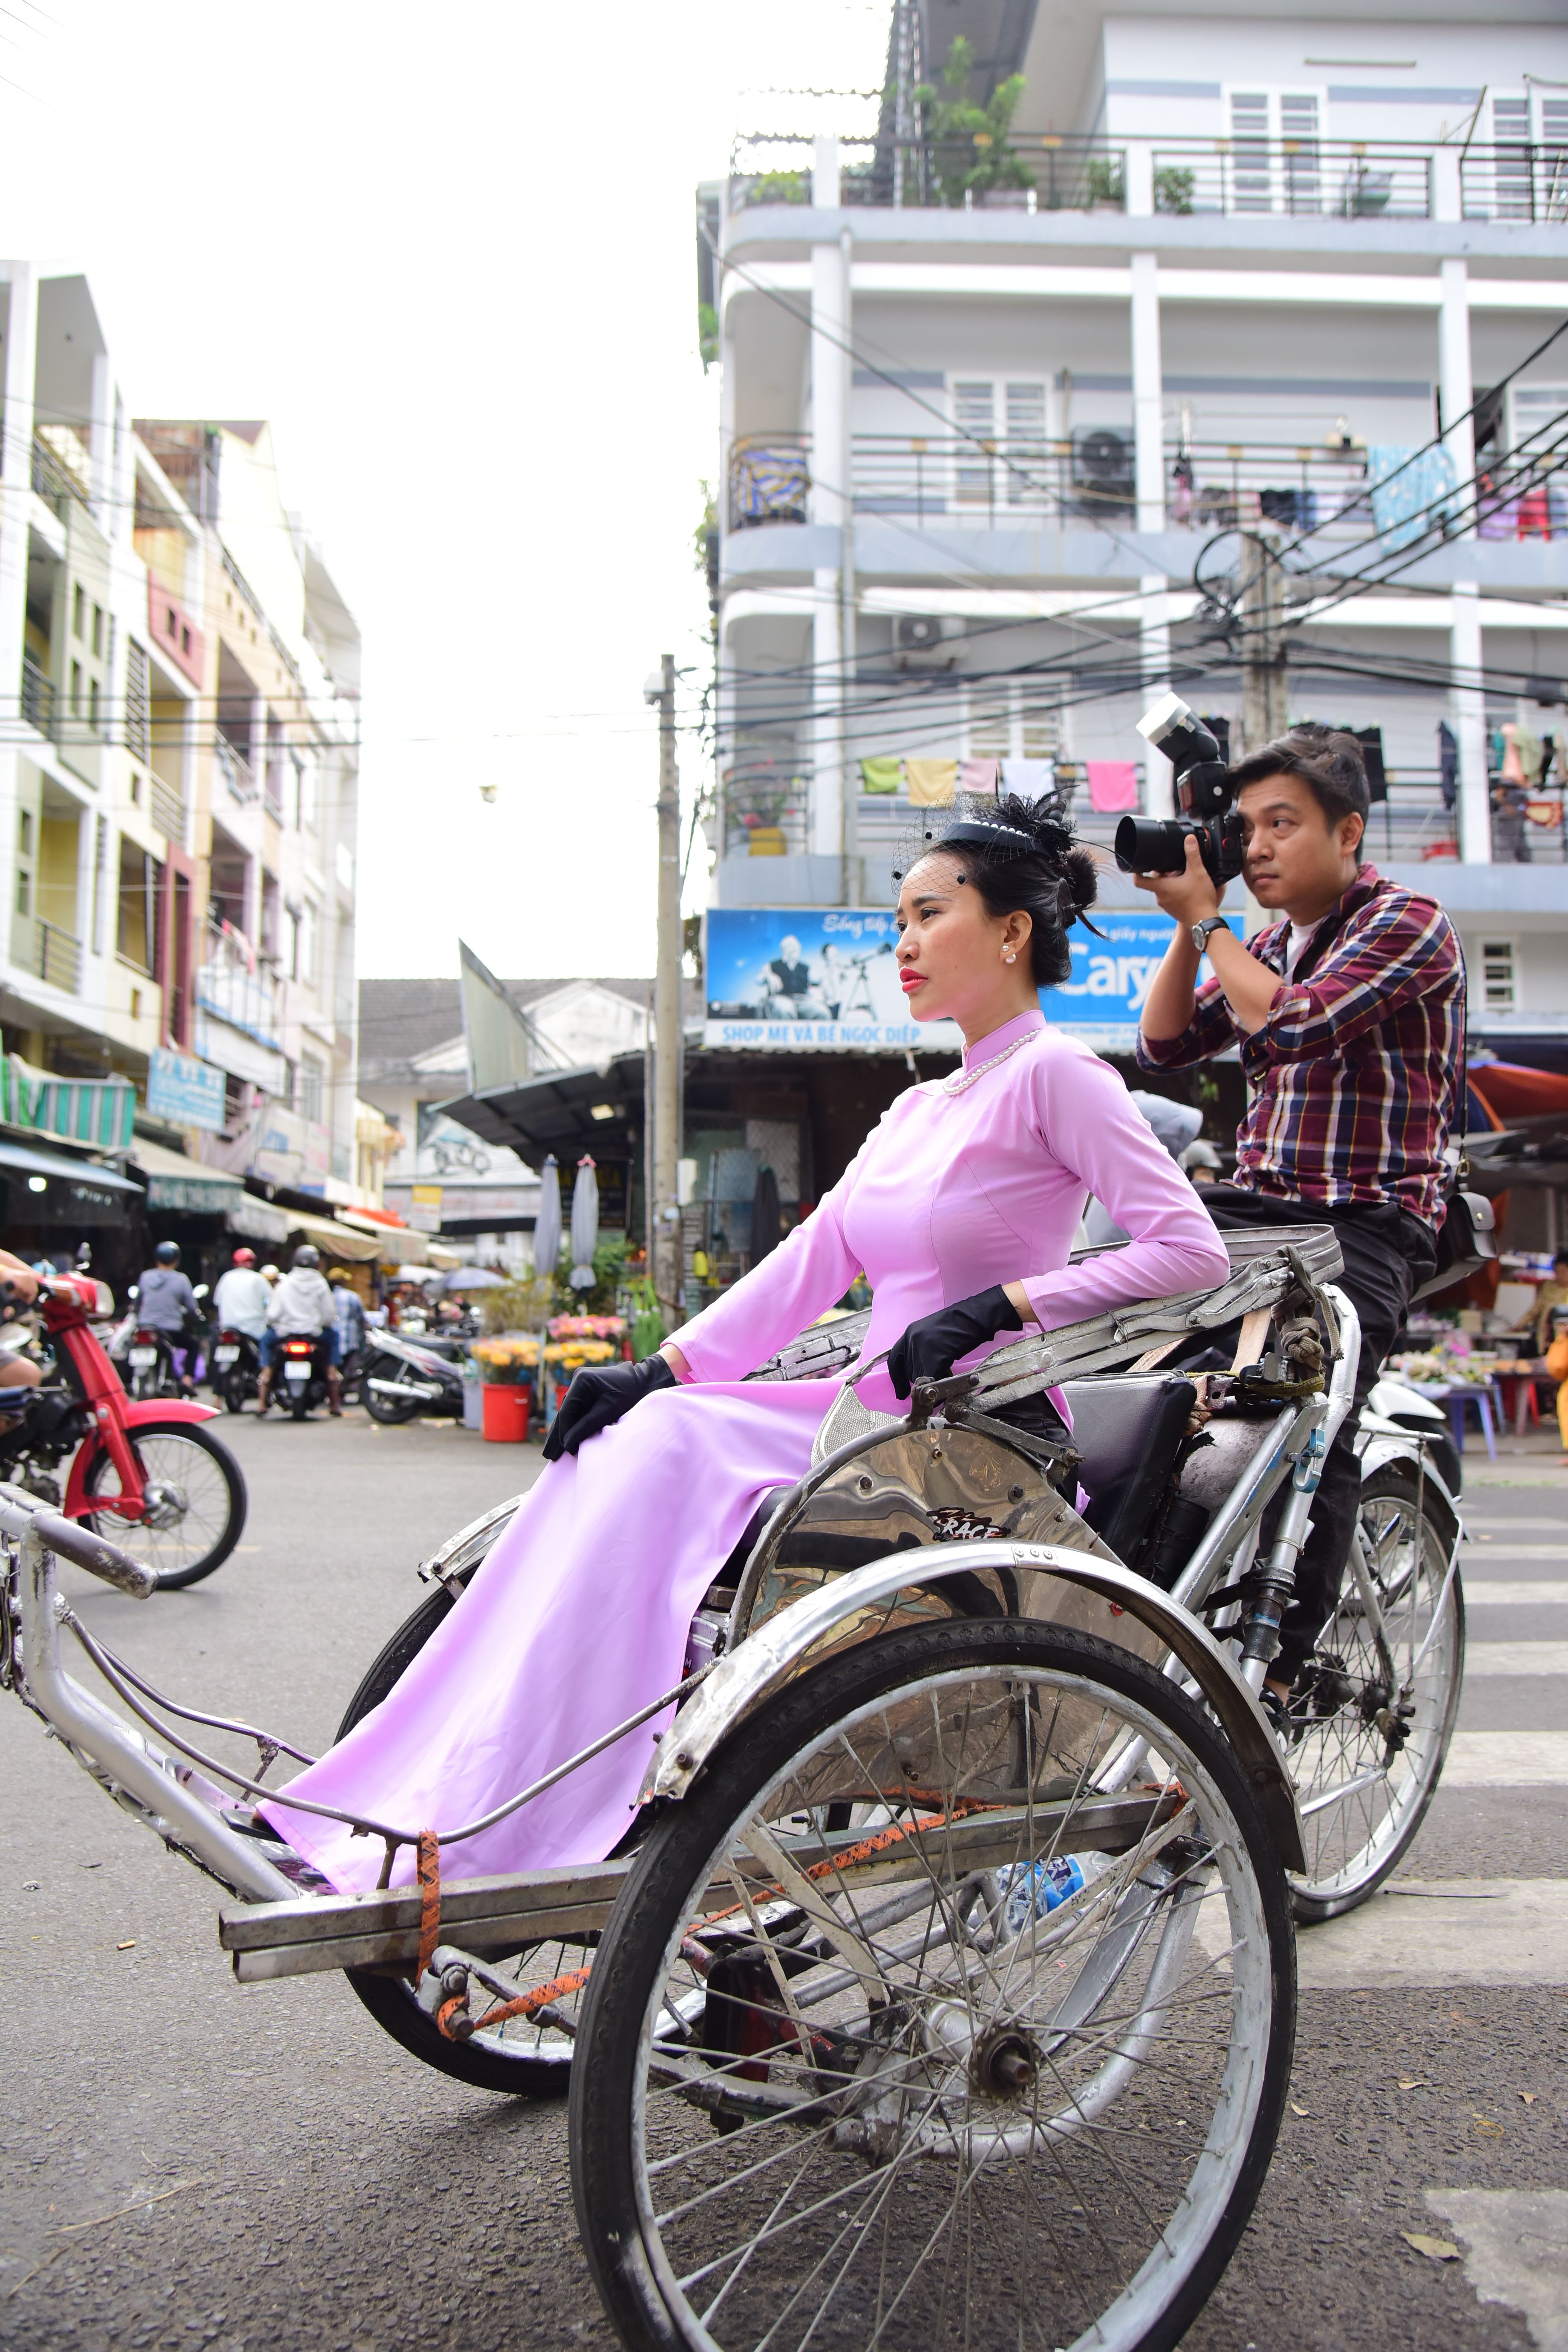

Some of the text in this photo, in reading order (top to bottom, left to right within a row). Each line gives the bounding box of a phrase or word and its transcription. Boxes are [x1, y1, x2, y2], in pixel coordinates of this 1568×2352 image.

[723, 1023, 921, 1044] SHOP MẸ VÀ BÉ NGỌC DIỆP
